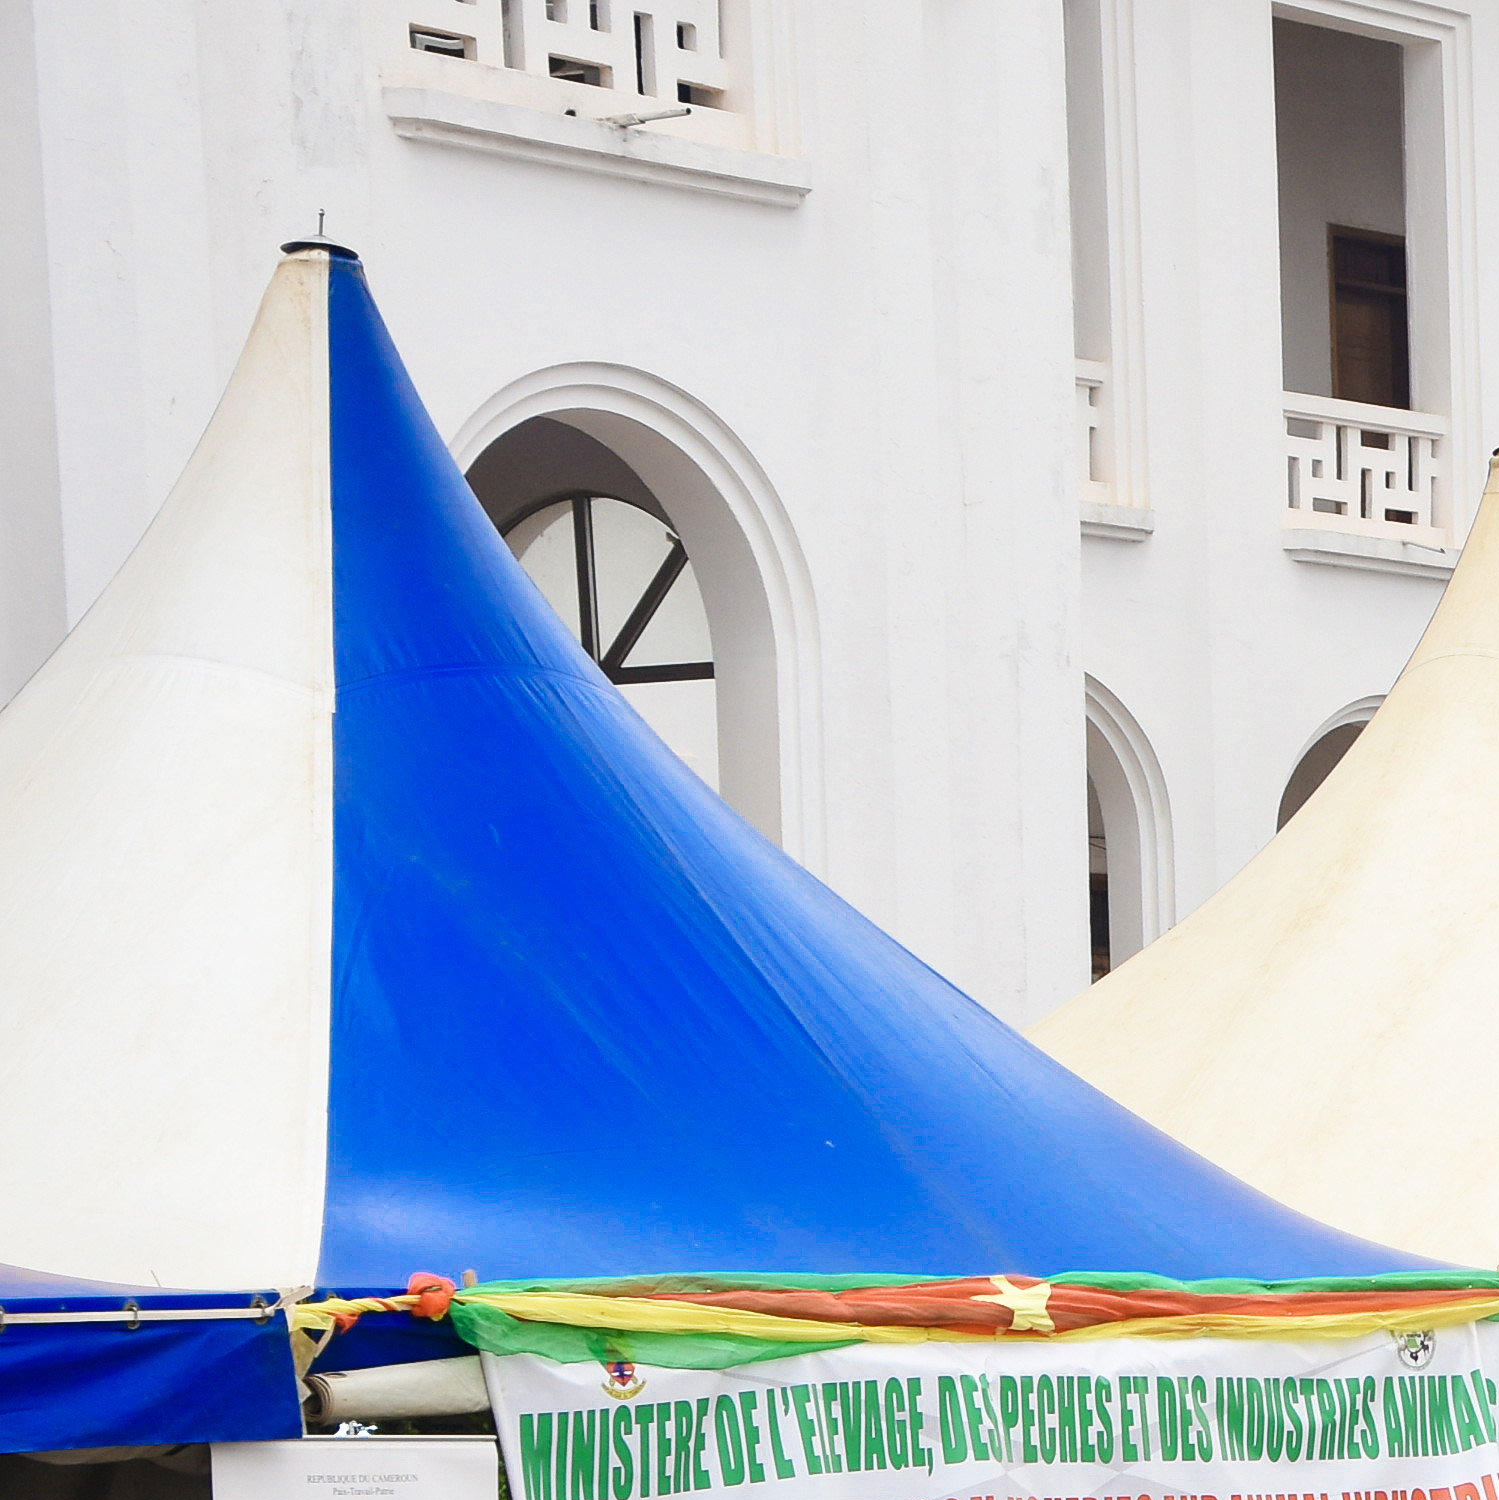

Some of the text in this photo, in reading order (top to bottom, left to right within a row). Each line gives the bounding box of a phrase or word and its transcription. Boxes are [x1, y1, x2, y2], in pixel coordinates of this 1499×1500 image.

[714, 1390, 767, 1488] DE
[937, 1372, 1002, 1465] DES
[1000, 1373, 1114, 1466] PECHES
[1118, 1375, 1151, 1463] ET
[1157, 1375, 1213, 1463] DES
[1216, 1376, 1380, 1464] INDUSTRIES
[306, 1474, 418, 1484] REPUBLIQUE DU CAMEROUN
